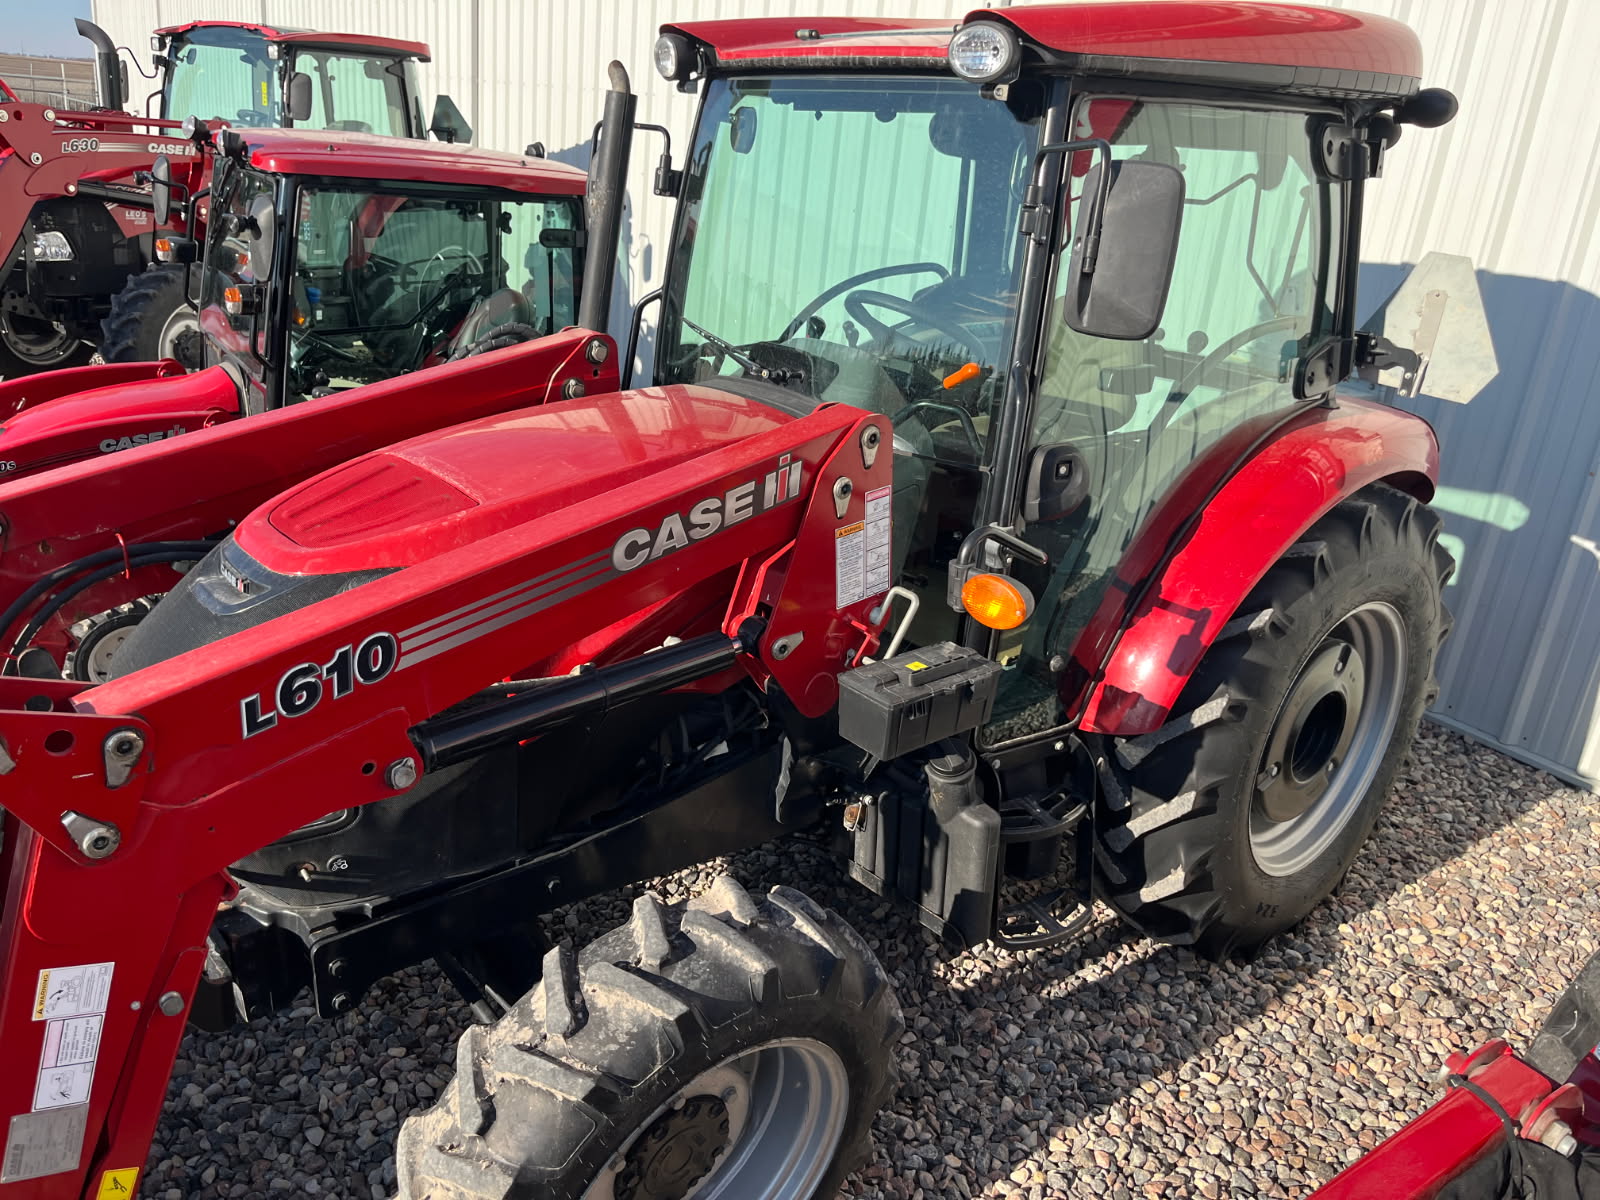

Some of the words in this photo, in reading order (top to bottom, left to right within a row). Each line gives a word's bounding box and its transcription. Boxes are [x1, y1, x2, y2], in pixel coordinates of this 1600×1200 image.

[61, 138, 99, 153] L630
[147, 142, 184, 155] CASE
[99, 431, 163, 453] CASE
[613, 480, 756, 572] CASE
[240, 631, 398, 740] L610
[39, 974, 49, 1007] WARNING
